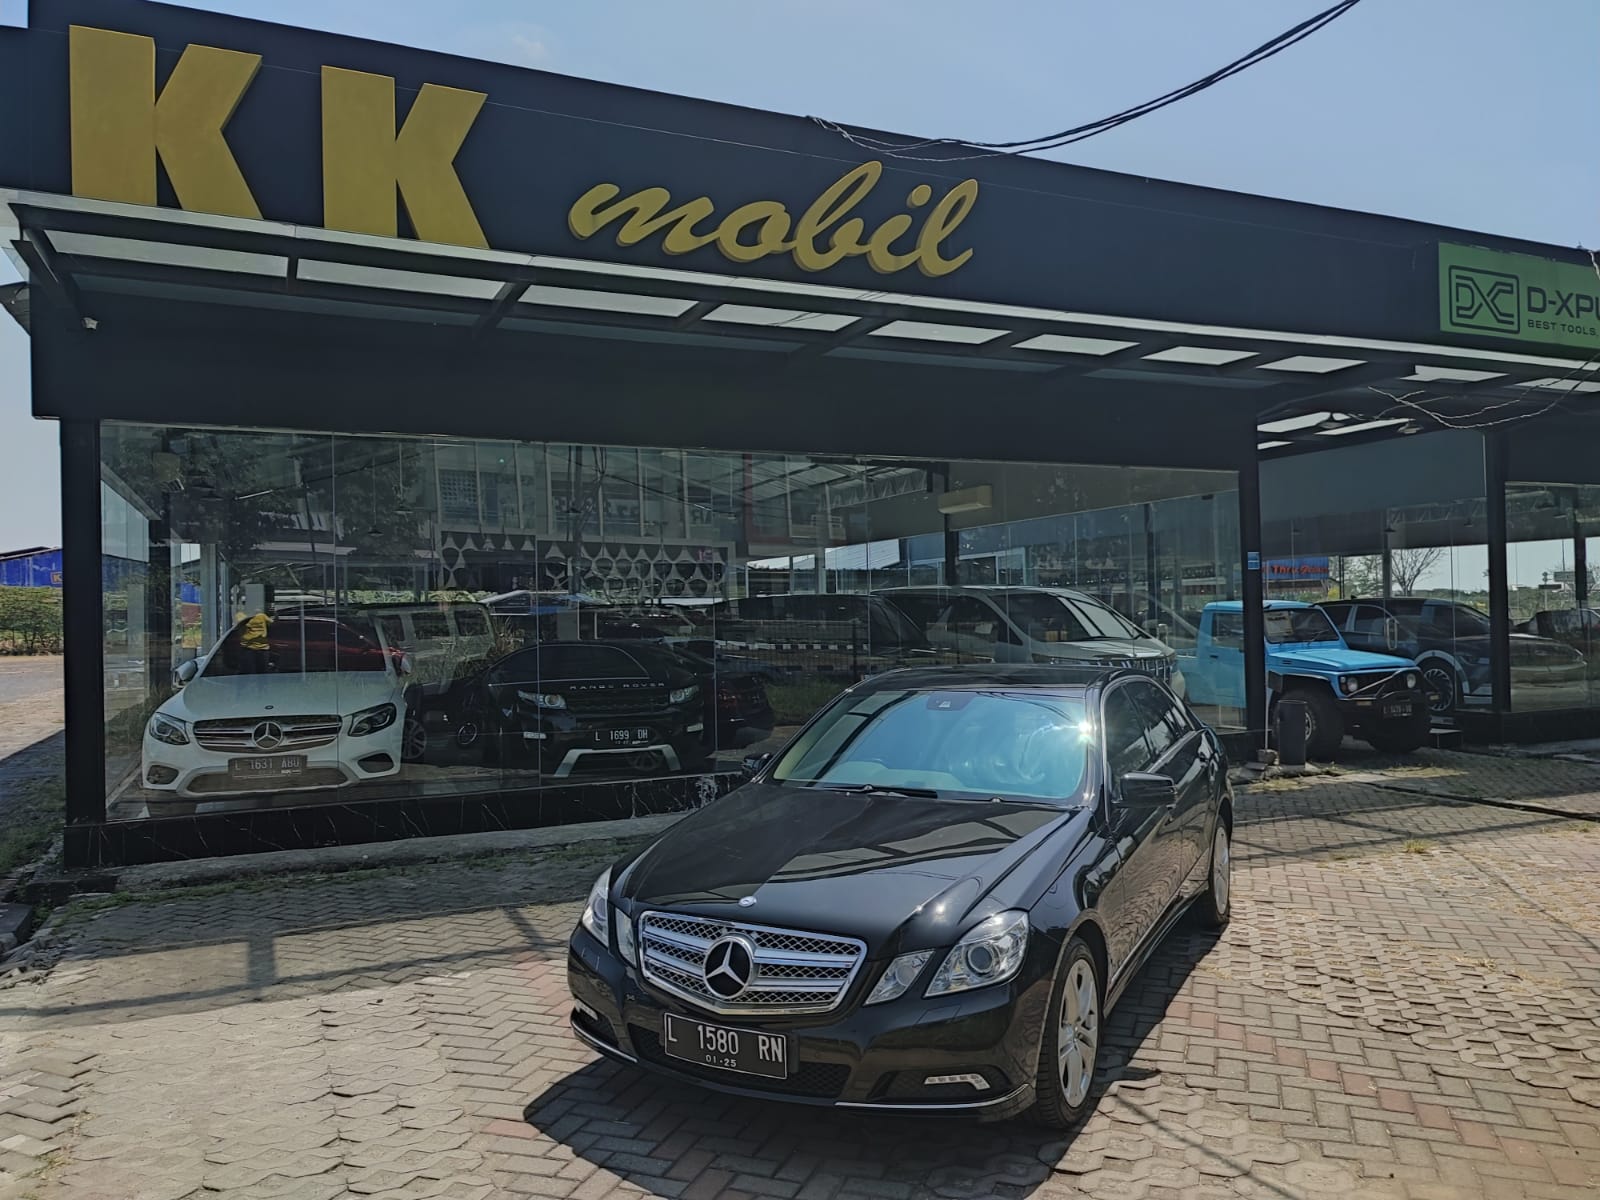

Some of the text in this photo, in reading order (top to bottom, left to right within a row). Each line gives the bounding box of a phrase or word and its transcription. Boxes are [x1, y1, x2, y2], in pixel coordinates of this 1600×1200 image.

[568, 160, 979, 277] mobil
[1528, 320, 1557, 330] BEST
[595, 731, 600, 741] L
[610, 730, 630, 741] 1699
[668, 1017, 783, 1063] L 1580 RN
